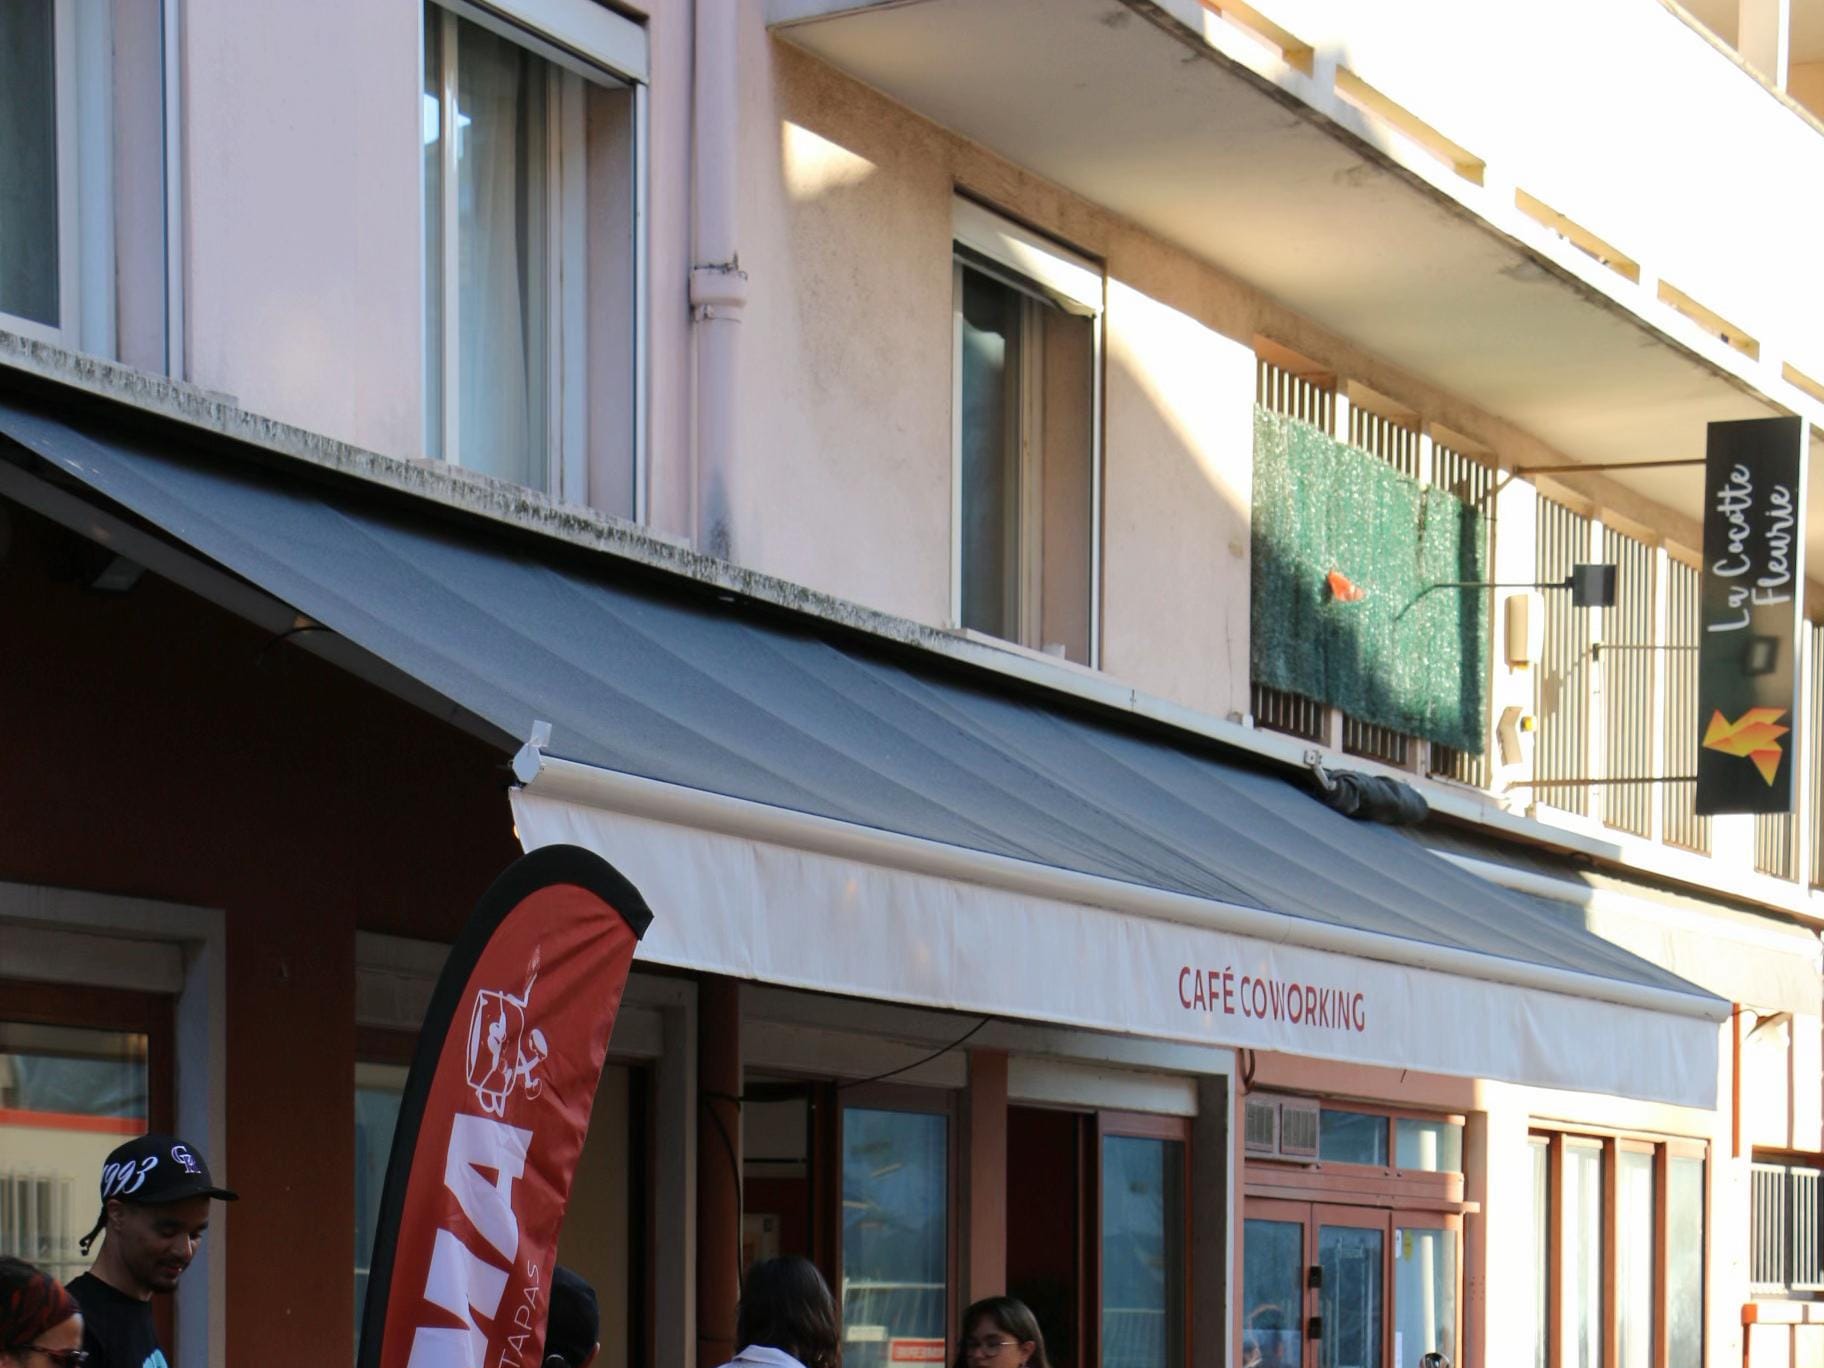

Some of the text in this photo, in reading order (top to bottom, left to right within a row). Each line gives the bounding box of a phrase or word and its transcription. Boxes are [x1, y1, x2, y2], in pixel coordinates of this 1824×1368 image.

[1707, 463, 1753, 632] La Cocotte
[1752, 484, 1796, 607] Fleurie
[1178, 965, 1366, 1033] CAFÉ COWORKING
[102, 1156, 159, 1197] 993
